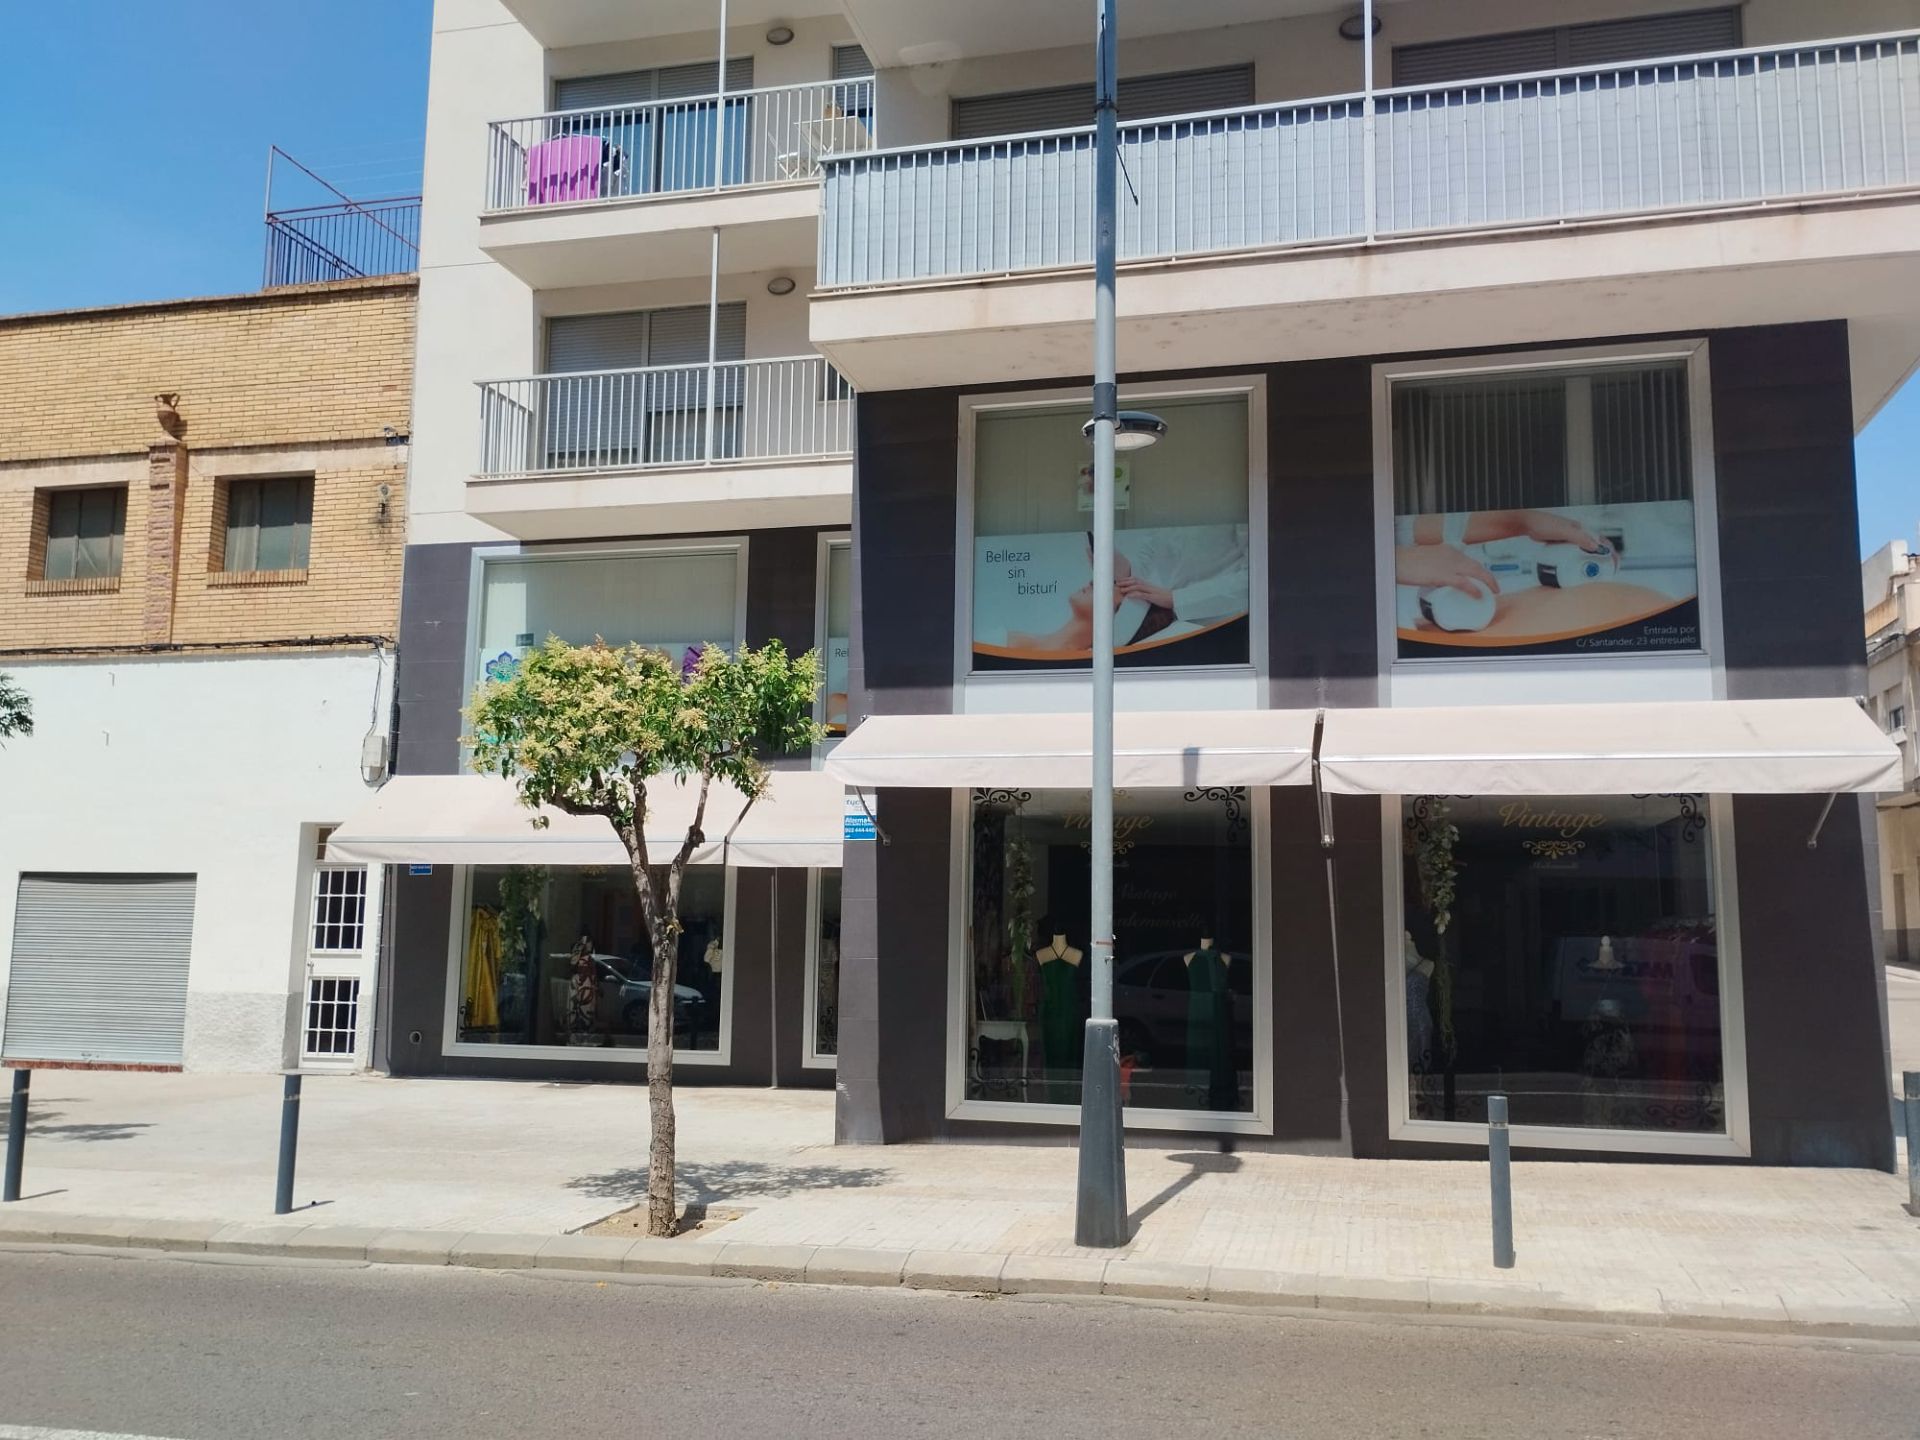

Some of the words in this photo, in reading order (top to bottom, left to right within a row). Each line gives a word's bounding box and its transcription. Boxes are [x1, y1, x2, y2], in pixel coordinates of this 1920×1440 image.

[985, 549, 1031, 563] Belleza
[1007, 566, 1026, 579] sin
[1017, 580, 1059, 595] bisturí
[1643, 625, 1678, 635] Entrada
[1680, 625, 1696, 636] por
[1575, 638, 1587, 648] C/
[1636, 636, 1648, 646] 23
[1649, 635, 1697, 645] entresuelo
[1498, 801, 1608, 838] Vintage
